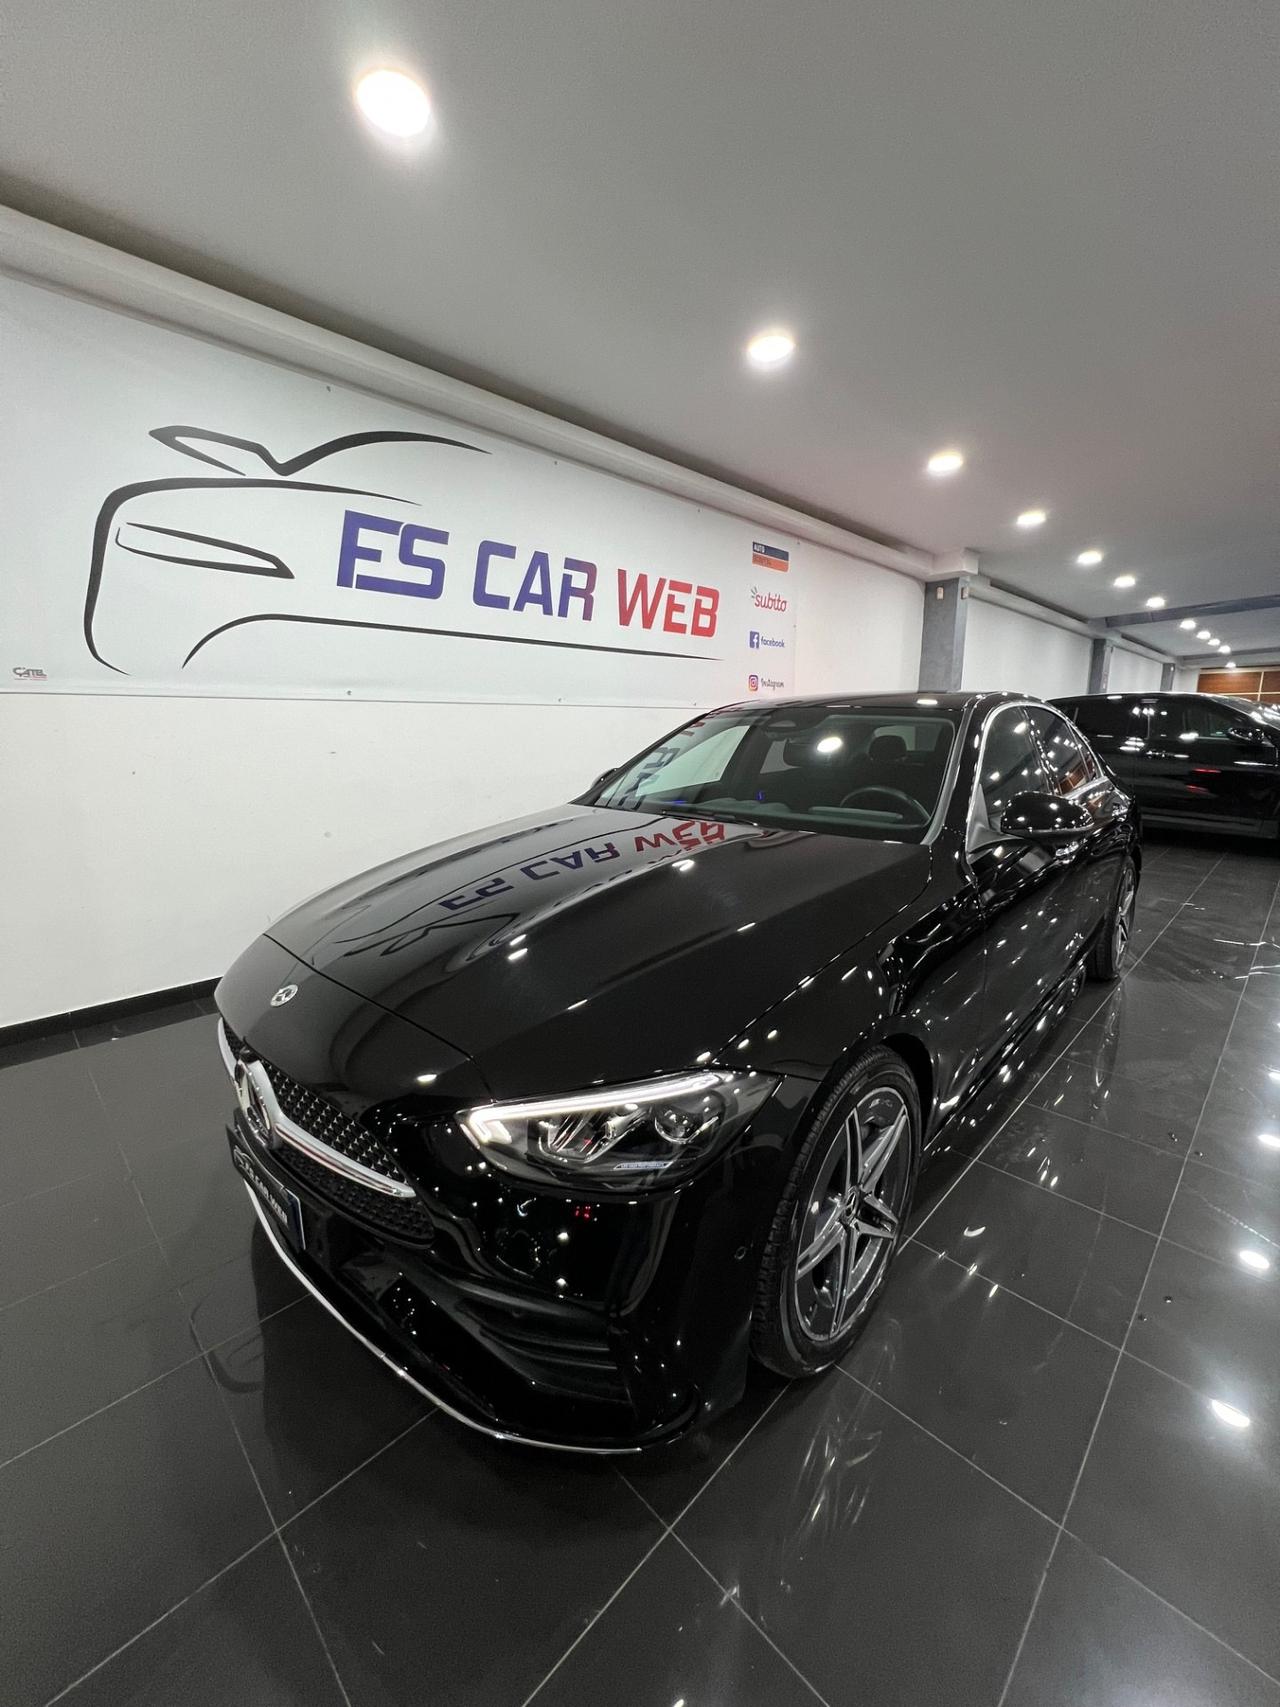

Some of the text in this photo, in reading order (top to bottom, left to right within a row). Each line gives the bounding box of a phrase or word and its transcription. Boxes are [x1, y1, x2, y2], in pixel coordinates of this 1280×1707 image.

[337, 509, 720, 638] ES CAR WEB
[754, 591, 787, 612] subito
[761, 636, 785, 648] facebook
